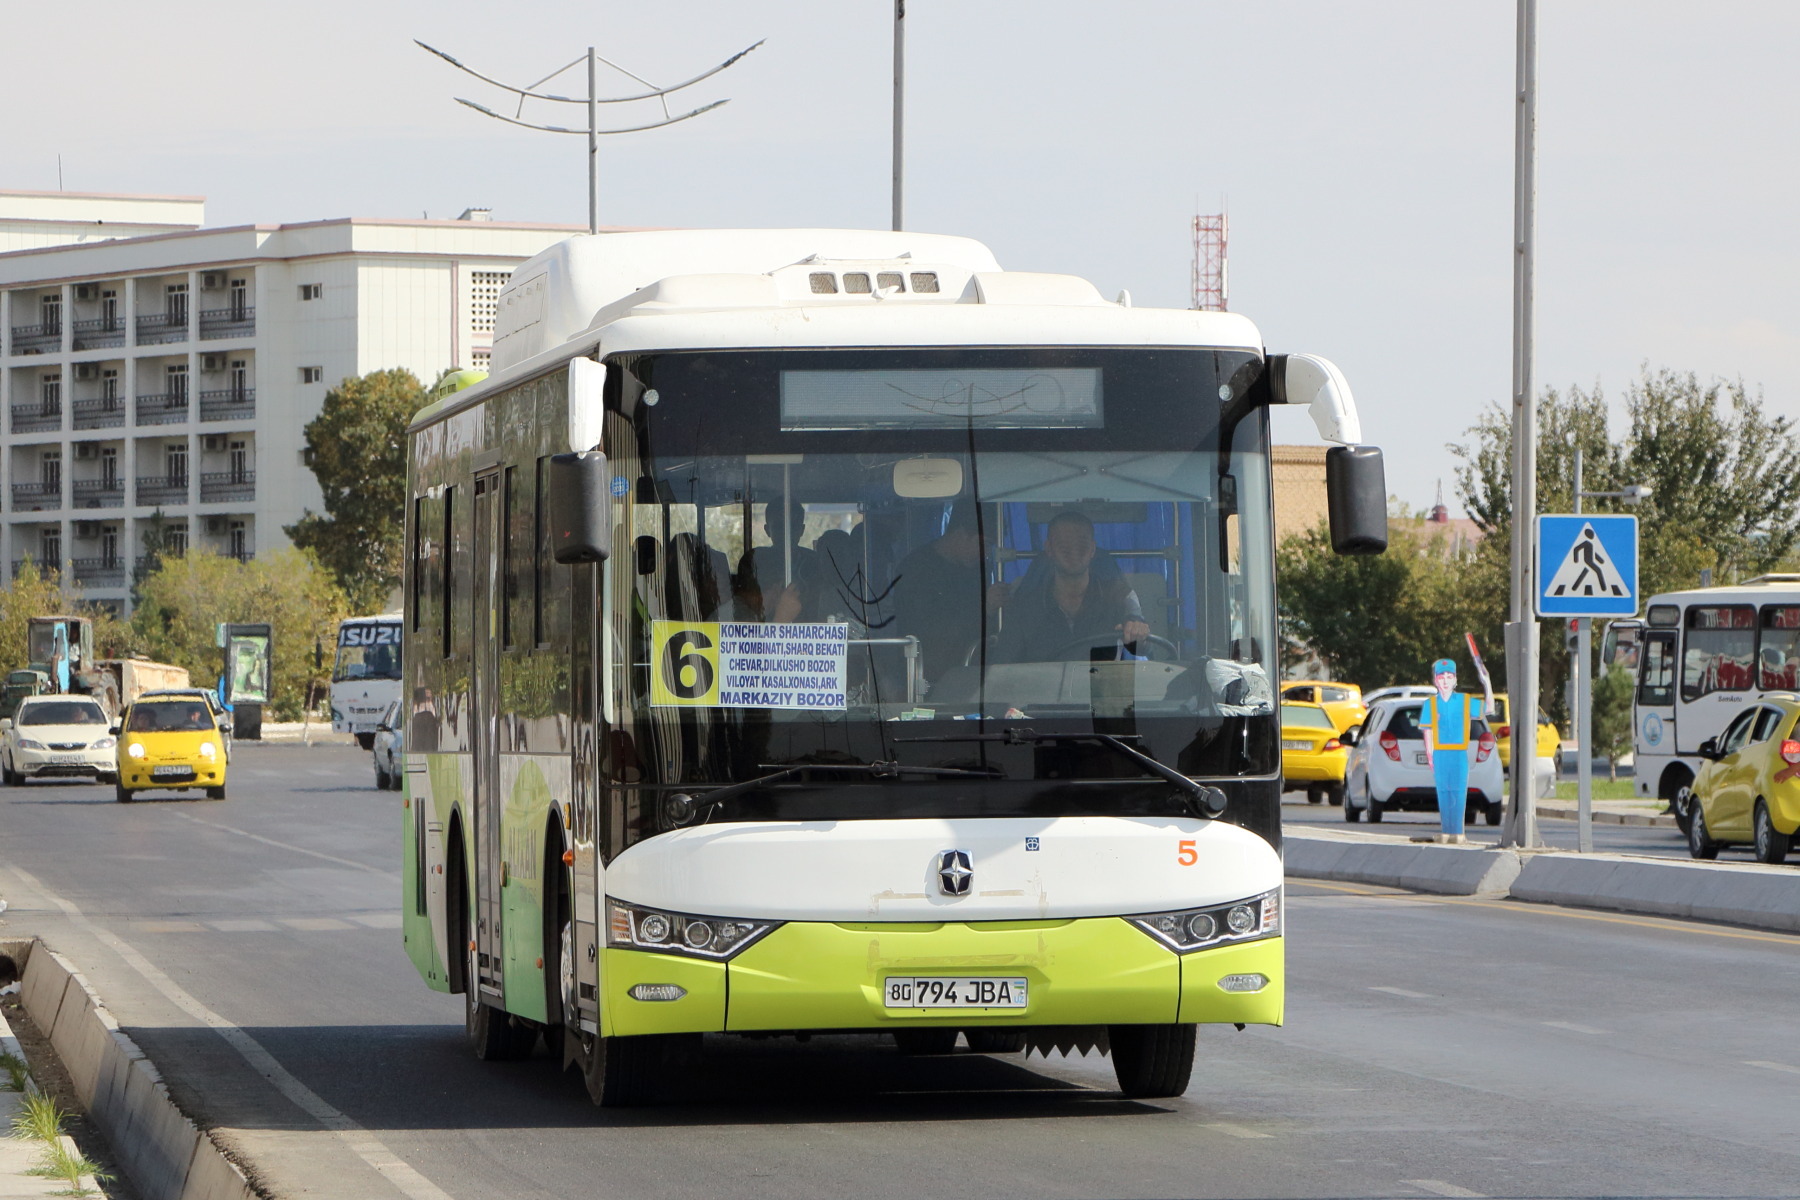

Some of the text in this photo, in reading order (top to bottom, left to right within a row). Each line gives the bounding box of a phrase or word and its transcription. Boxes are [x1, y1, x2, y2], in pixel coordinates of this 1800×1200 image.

[721, 624, 847, 640] KONCHILAR SHAHARCHASI
[720, 641, 845, 657] SUT KOMBINATI,SHARQ BEKATI
[661, 630, 714, 699] 6
[729, 658, 836, 674] CHEVAR,DILKUSHO BOZOR
[726, 675, 760, 688] VILOYAT
[720, 691, 845, 706] MARKAZIY BOZOR
[1177, 840, 1198, 867] 5
[891, 983, 911, 1001] 80
[916, 981, 958, 1003] 794
[965, 981, 1012, 1003] JBA
